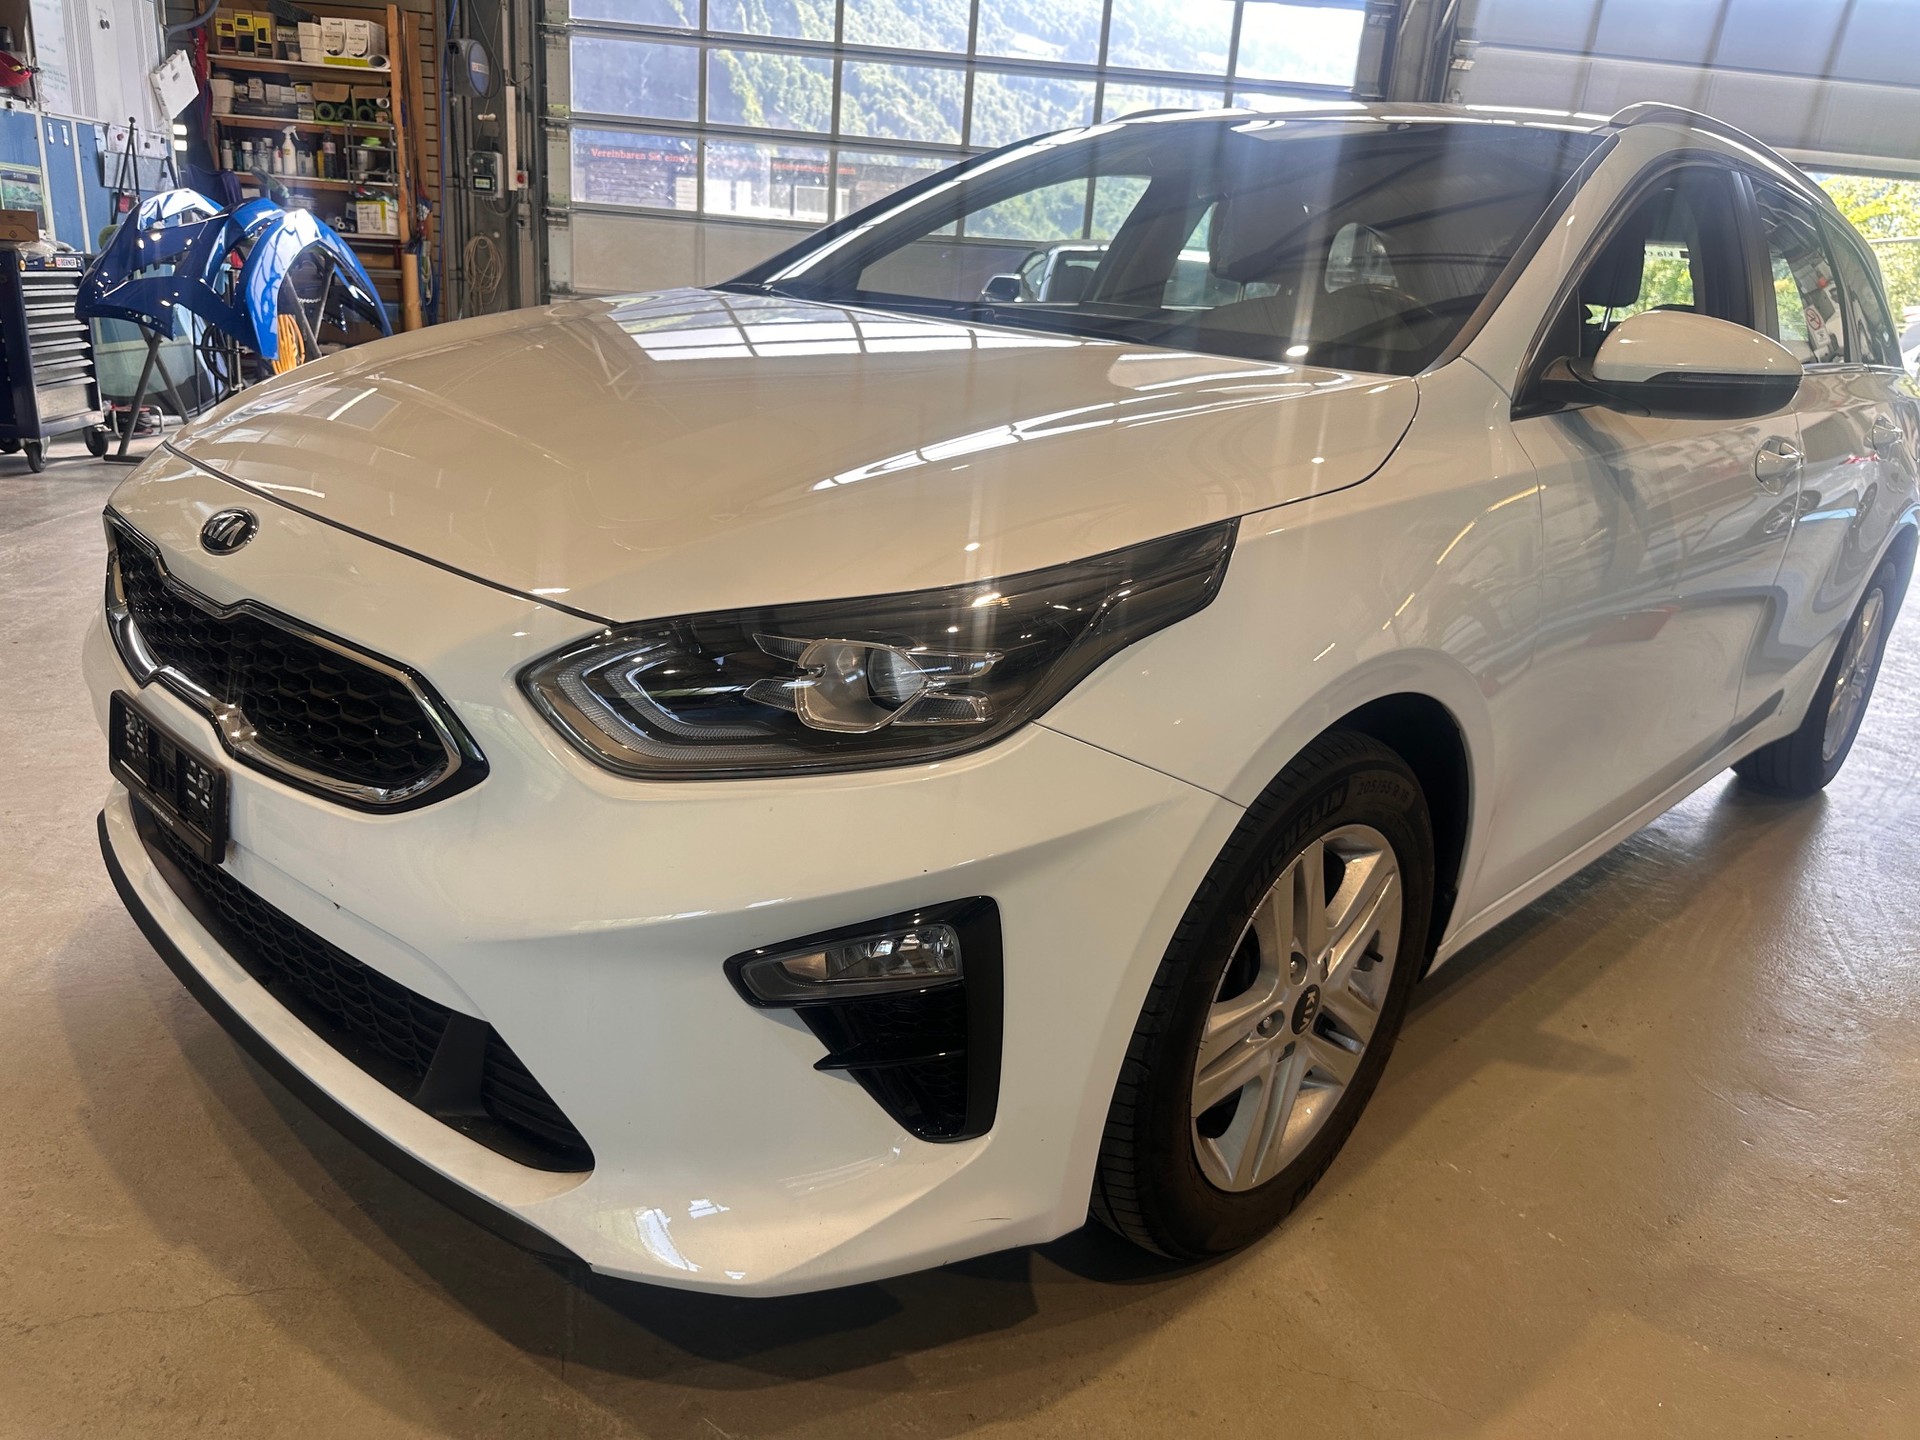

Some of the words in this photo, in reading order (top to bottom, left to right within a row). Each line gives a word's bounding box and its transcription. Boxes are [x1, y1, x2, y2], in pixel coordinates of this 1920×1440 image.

[591, 148, 646, 160] Vereinbaren
[1356, 779, 1392, 796] 205/55
[1243, 786, 1345, 905] MICHELIN
[1300, 991, 1316, 1031] KIA
